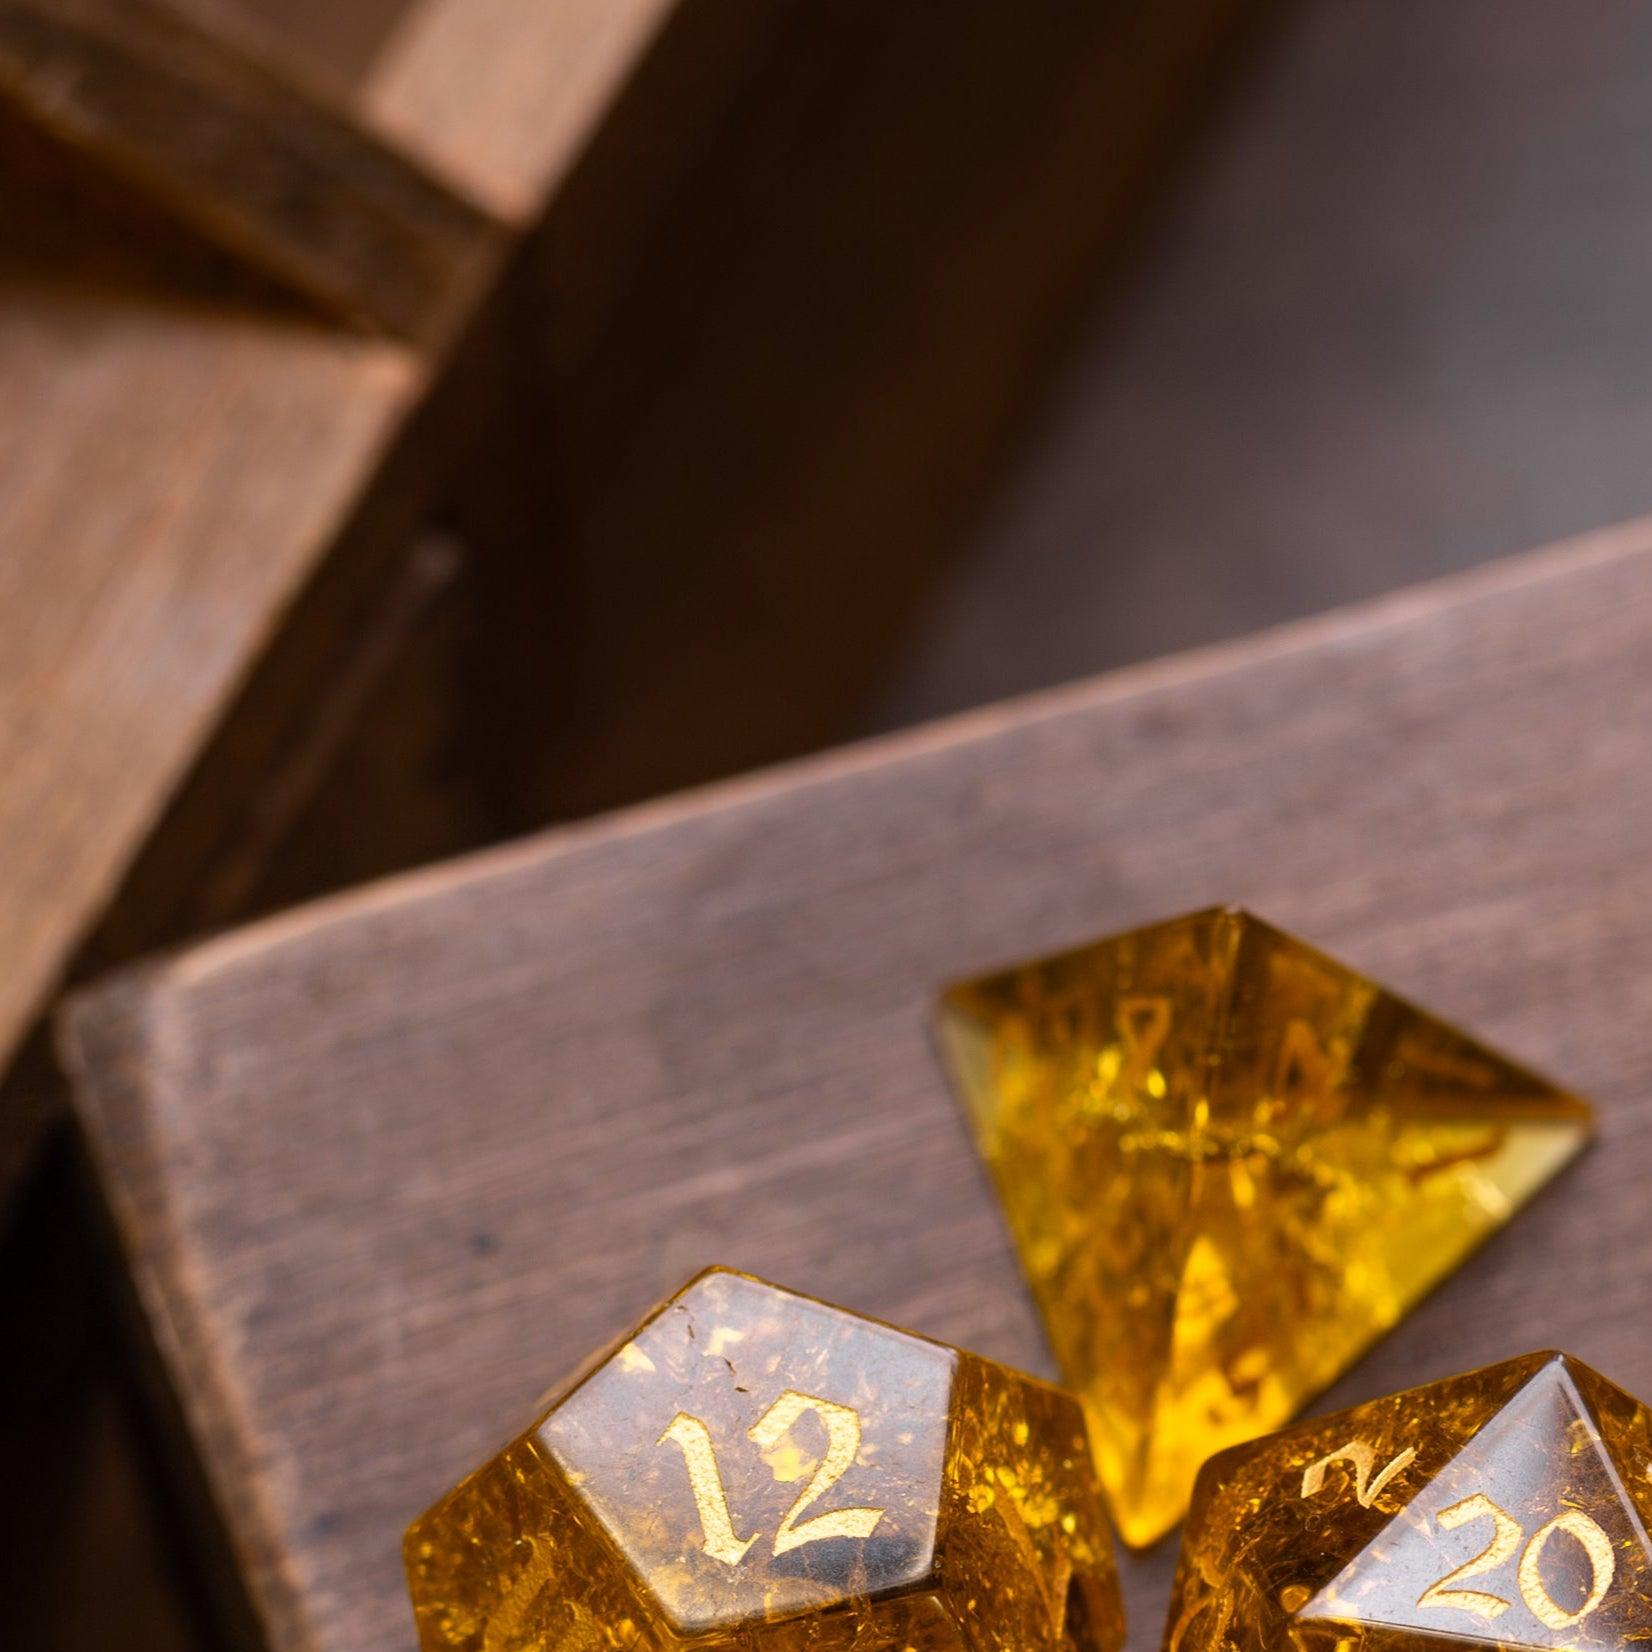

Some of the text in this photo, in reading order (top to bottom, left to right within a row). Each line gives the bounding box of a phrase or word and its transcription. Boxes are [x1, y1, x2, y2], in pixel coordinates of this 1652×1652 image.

[656, 1389, 888, 1567] 12
[1301, 1440, 1417, 1510] 2
[1415, 1493, 1616, 1630] 20
